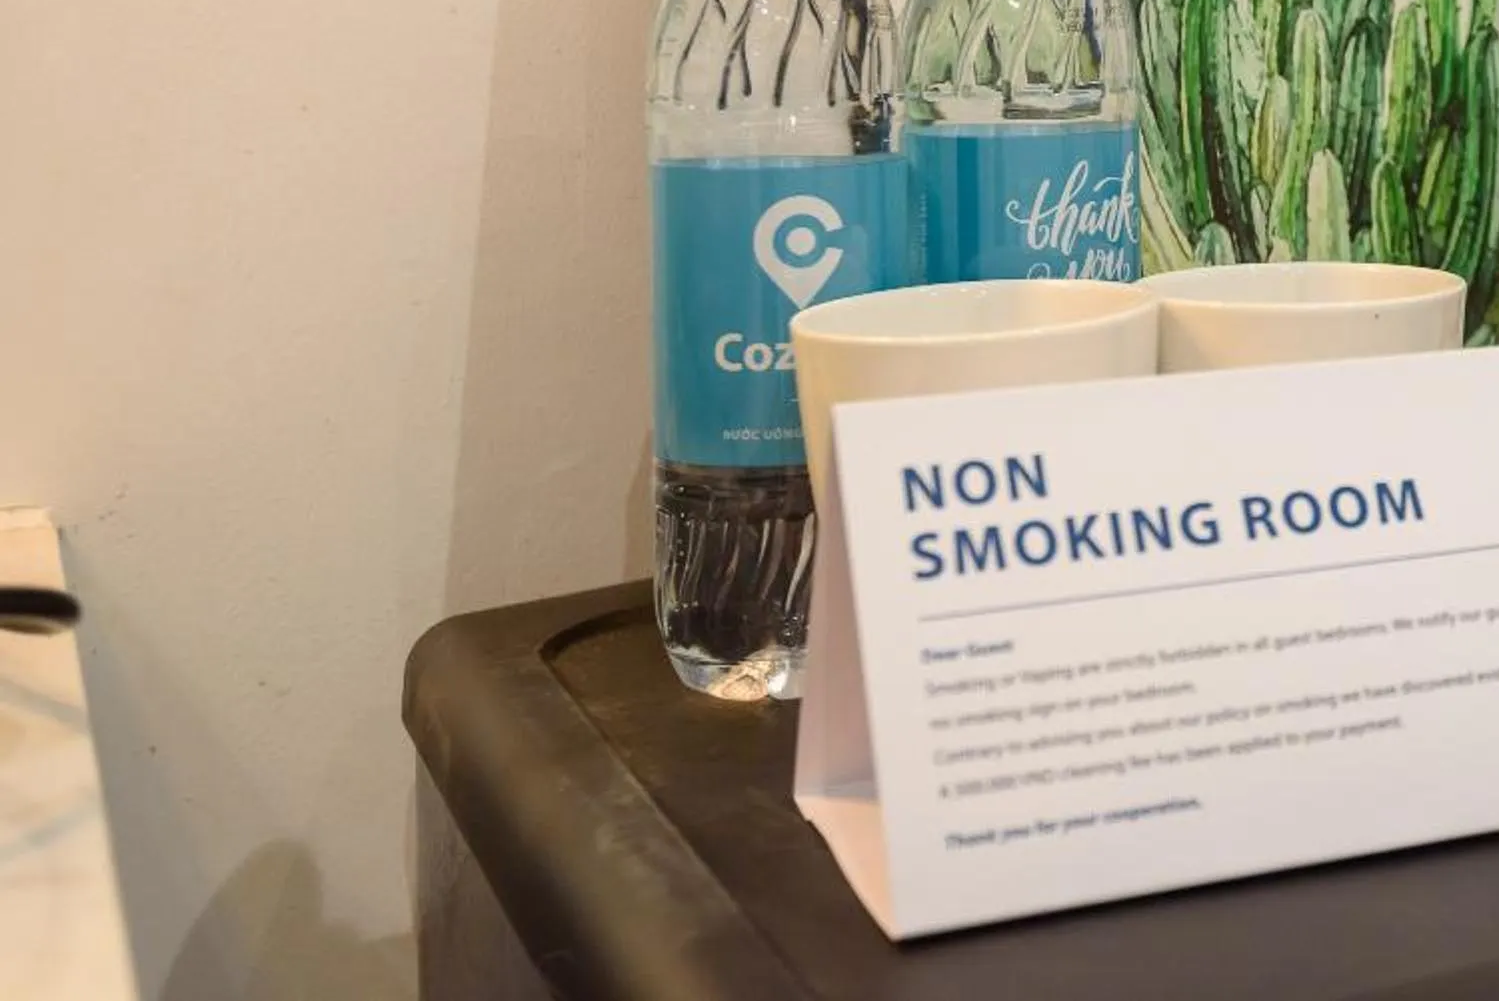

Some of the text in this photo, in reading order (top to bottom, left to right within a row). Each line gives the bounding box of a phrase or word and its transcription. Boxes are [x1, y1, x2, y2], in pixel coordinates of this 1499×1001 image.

[1005, 151, 1140, 256] thank
[901, 455, 1048, 510] NON
[910, 477, 1425, 581] SMOKING ROOM
